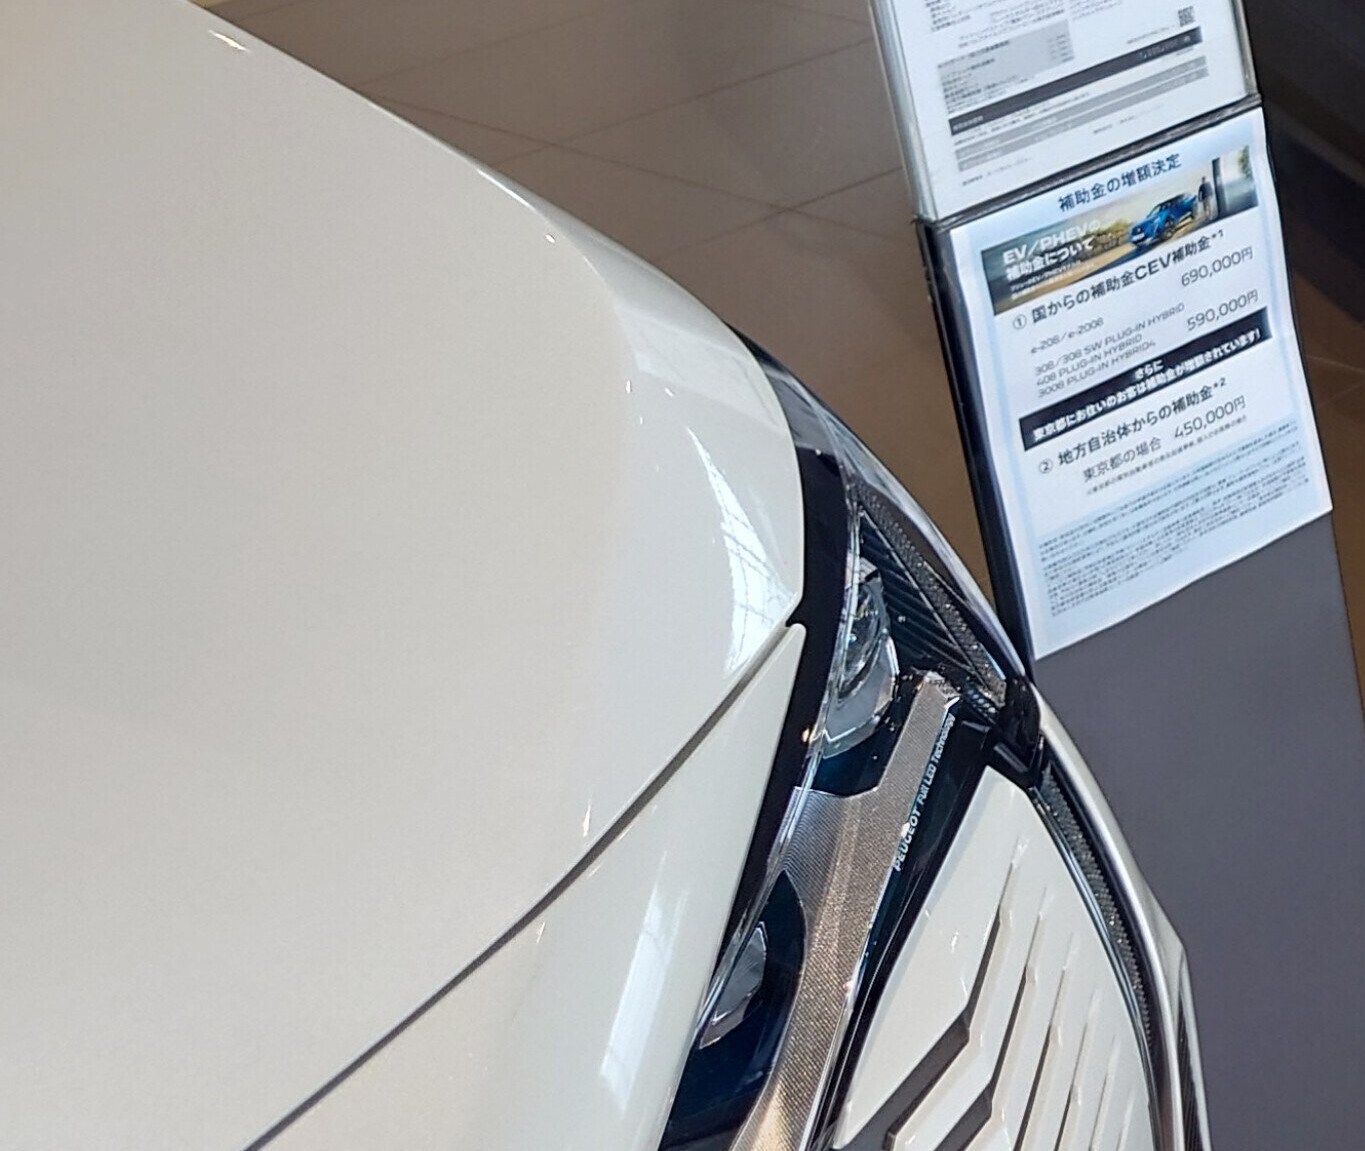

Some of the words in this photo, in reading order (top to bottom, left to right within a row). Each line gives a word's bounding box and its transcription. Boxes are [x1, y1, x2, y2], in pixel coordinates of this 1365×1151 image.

[1057, 152, 1181, 212] 補助金の増額決定
[1004, 234, 1095, 282] 補助金について
[1180, 245, 1253, 288] 690,000円
[1083, 339, 1103, 354] SW
[1104, 321, 1146, 346] PLUG-IN
[1146, 302, 1185, 326] HYBRID
[1186, 288, 1259, 332] 590,000円
[1035, 370, 1057, 386] 408
[1058, 351, 1102, 377] PLUG-IN
[1103, 333, 1142, 357] HYBRID
[1037, 379, 1065, 398] 3008
[1065, 359, 1110, 386] PLUG-IN
[1110, 337, 1156, 365] HYBRID4
[1133, 358, 1164, 381] さらに
[1082, 435, 1161, 483] 東京都の場合
[1173, 394, 1246, 440] 450,000円
[893, 811, 922, 872] PEUGEOT
[923, 765, 937, 786] LED
[933, 713, 956, 764] Technology
